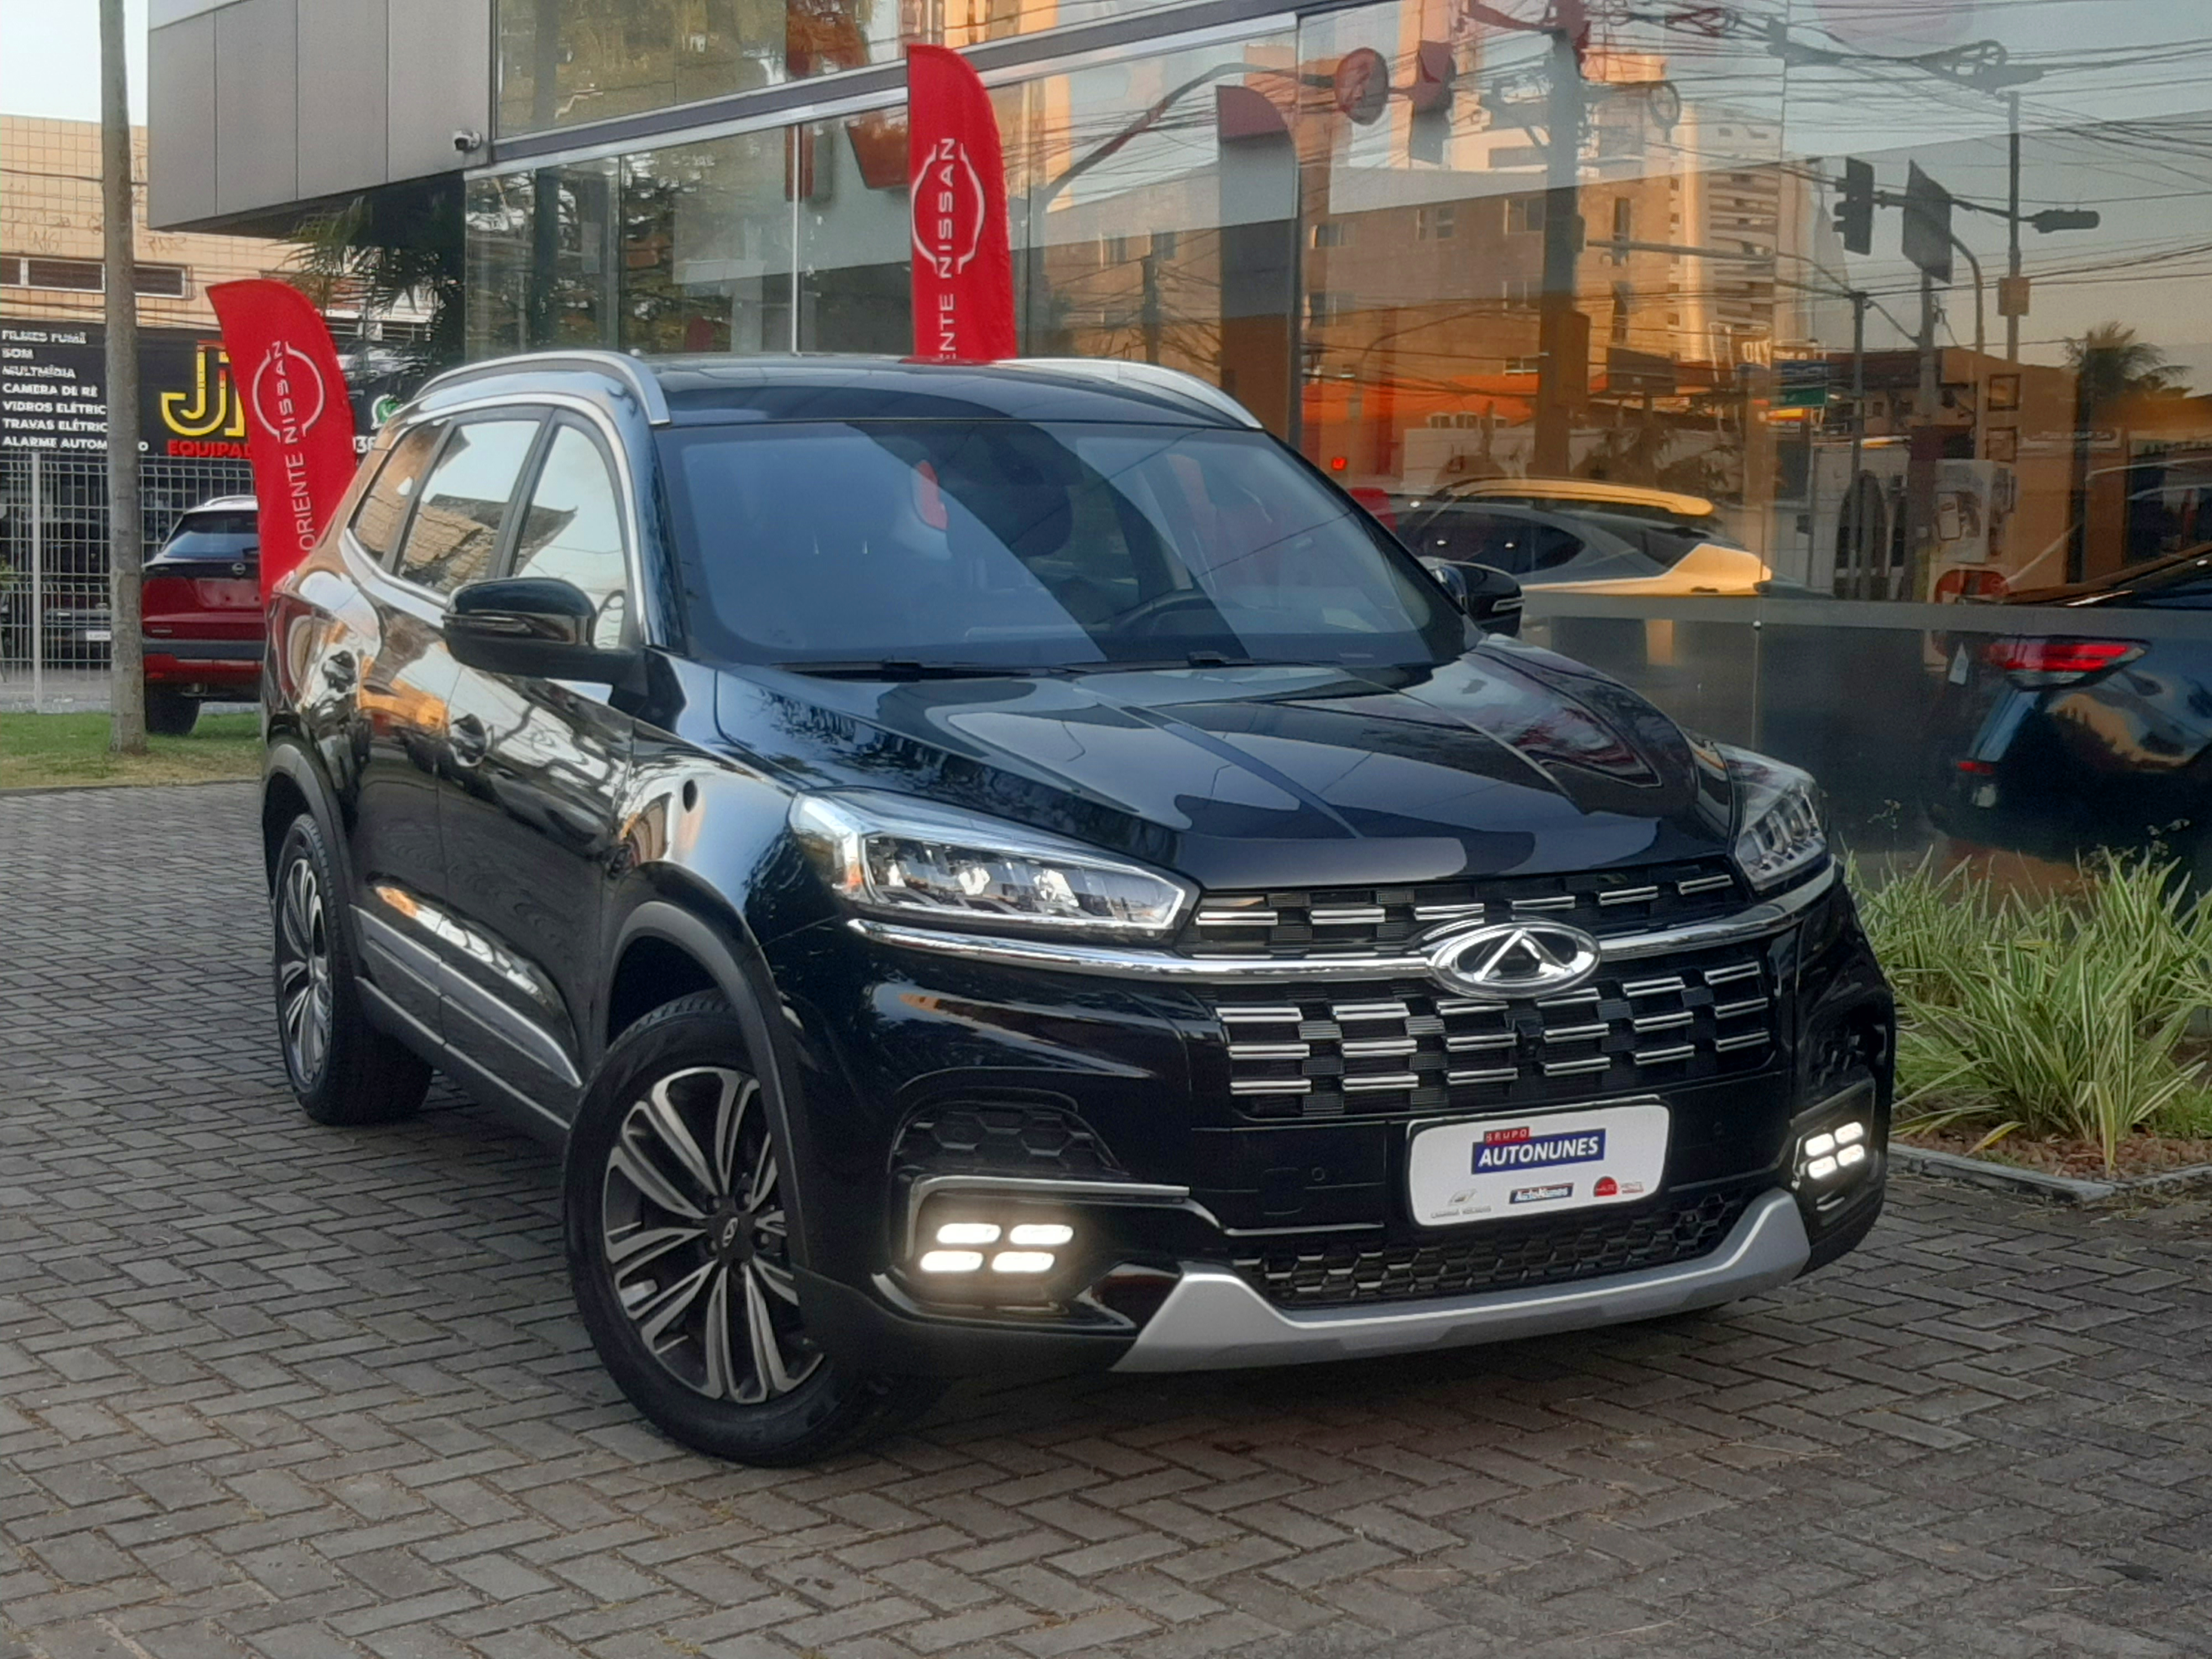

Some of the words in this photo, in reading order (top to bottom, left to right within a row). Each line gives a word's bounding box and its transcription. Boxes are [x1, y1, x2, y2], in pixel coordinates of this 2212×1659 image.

[938, 138, 956, 278] NISSAN
[61, 385, 79, 397] DE
[272, 340, 298, 444] NISSAN
[2, 400, 53, 413] VIDROS
[56, 401, 107, 415] ELÉTRIC
[2, 418, 55, 430] TRAVAS
[58, 418, 108, 432] ELÉTRIC
[2, 436, 58, 447] ALARME
[285, 450, 317, 551] ORIENTE
[1486, 1128, 1527, 1143] GRUPO
[1478, 1136, 1599, 1167] AUTONUNES
